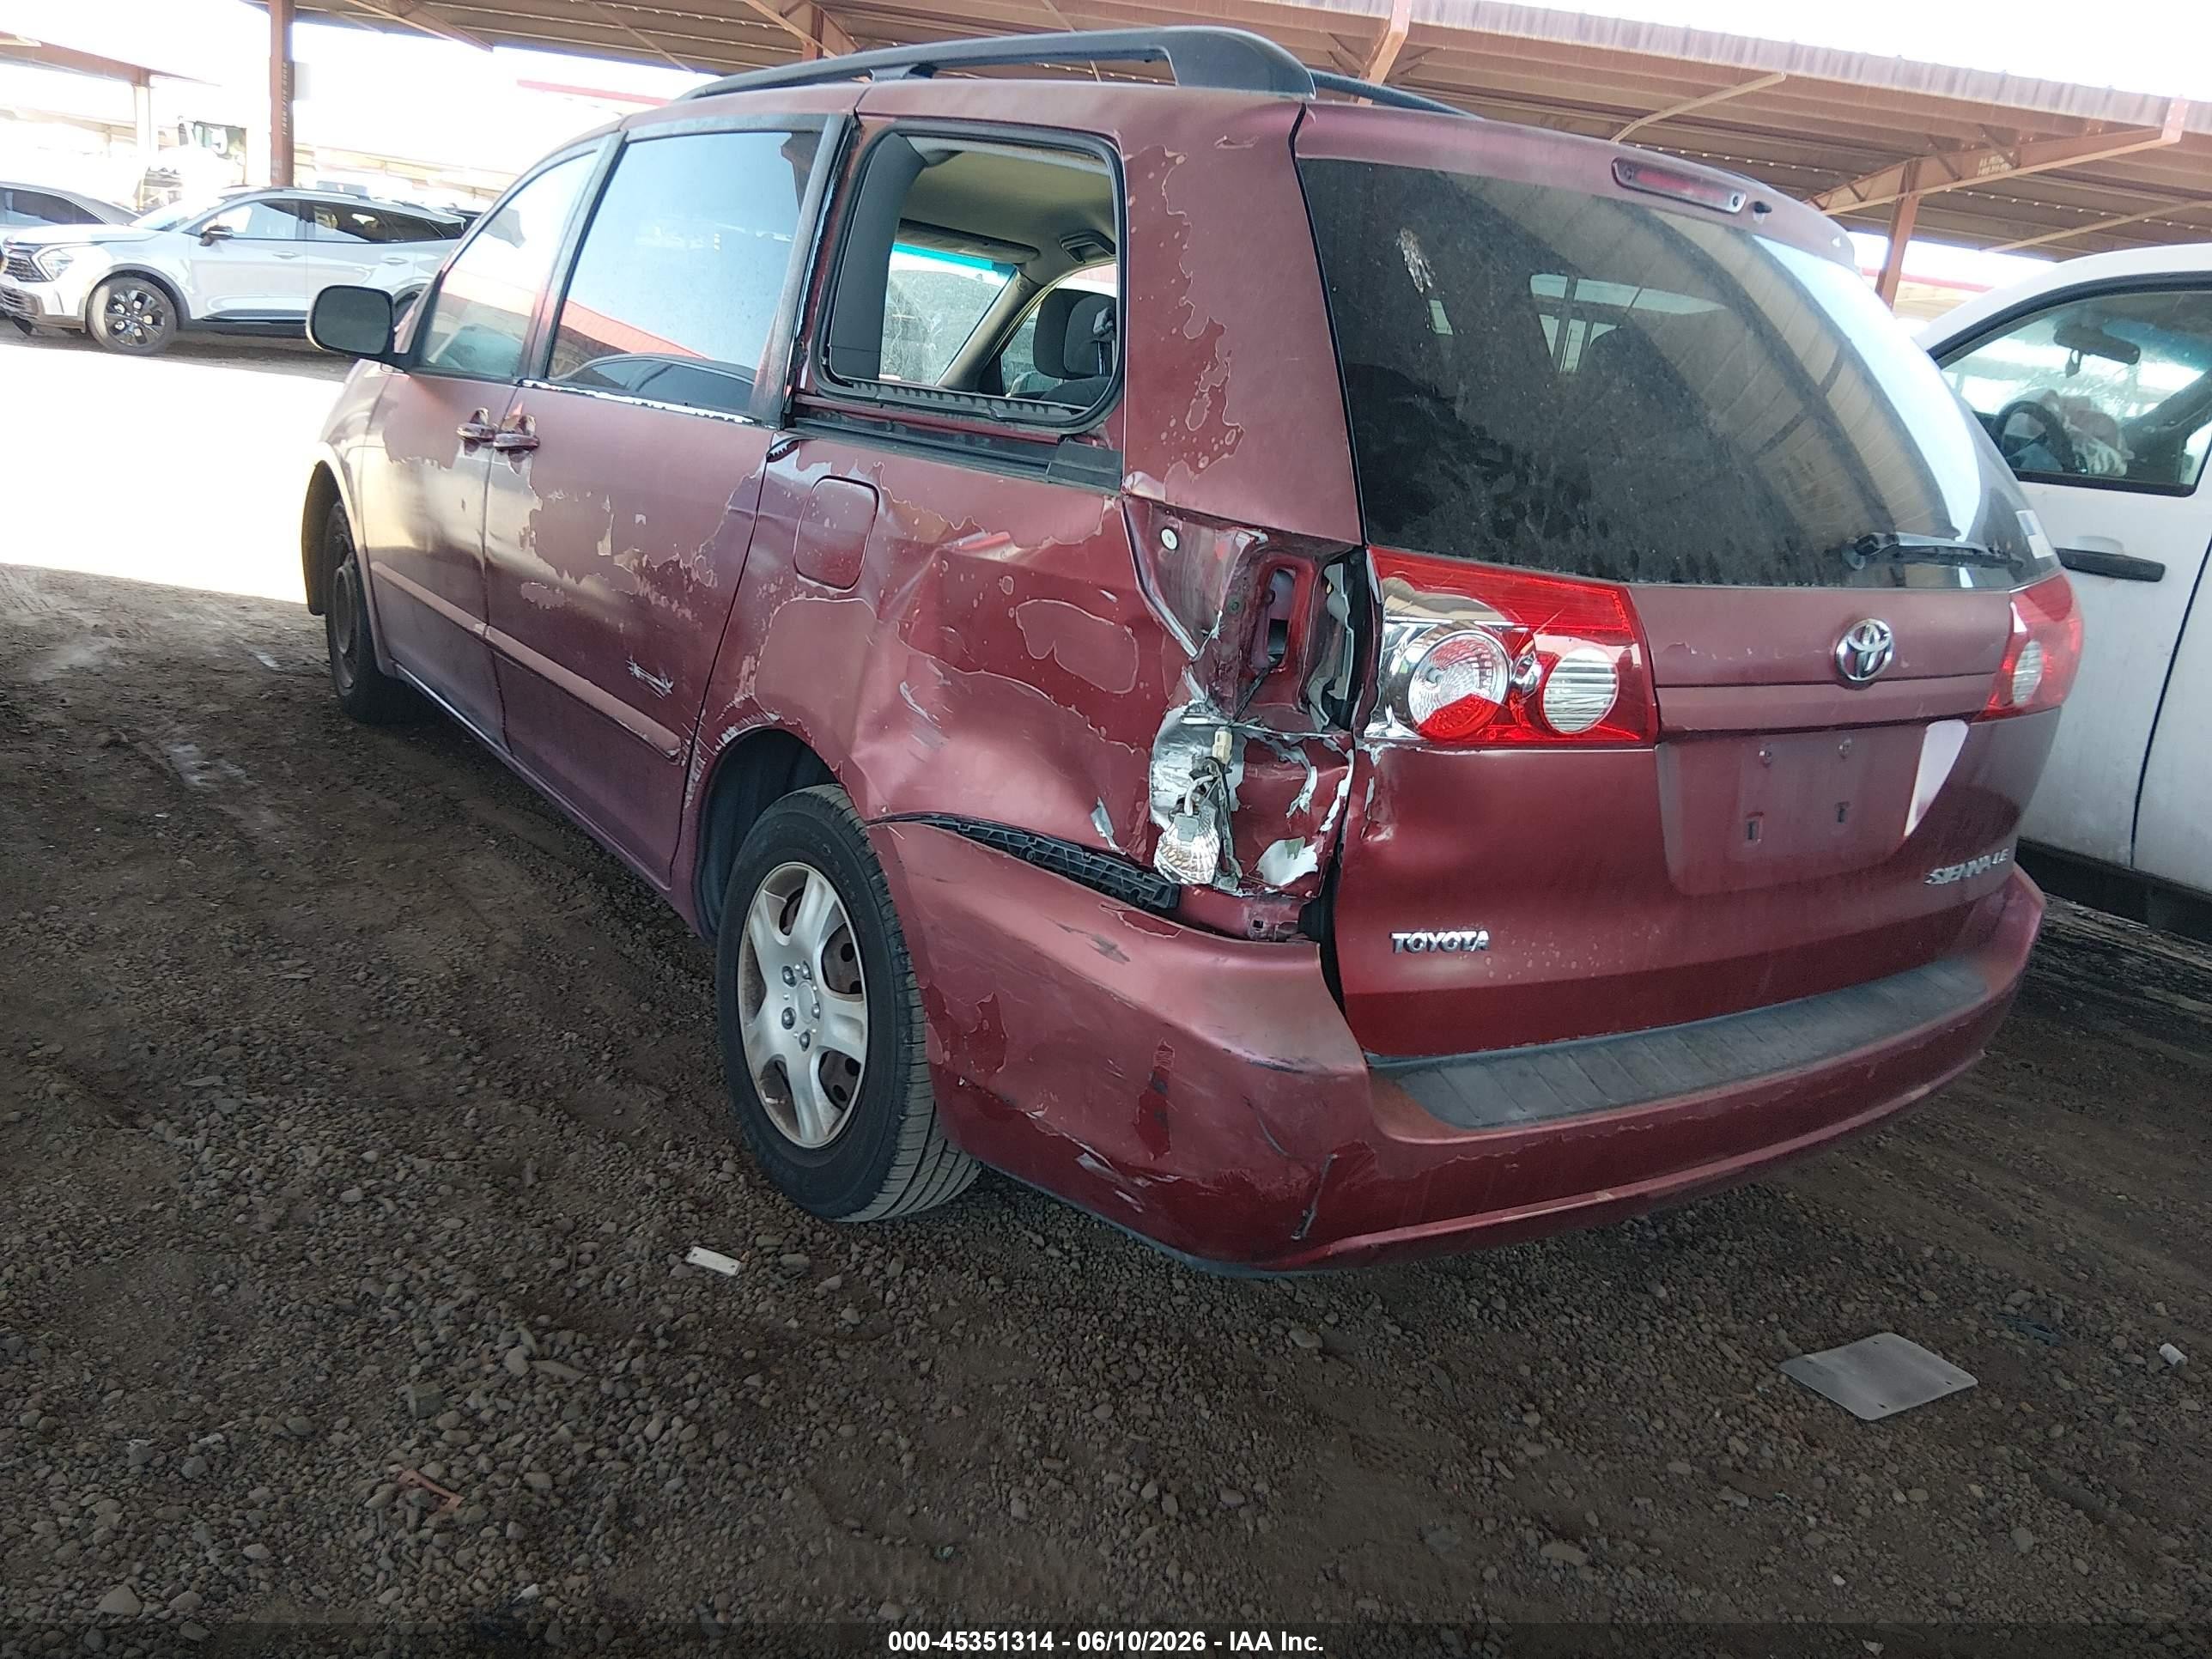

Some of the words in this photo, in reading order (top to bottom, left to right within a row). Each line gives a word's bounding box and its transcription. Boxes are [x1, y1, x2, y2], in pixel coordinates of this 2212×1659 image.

[1923, 854, 1992, 885] SIENNA
[1992, 848, 2009, 865] LE
[1390, 930, 1490, 954] TOYOTA
